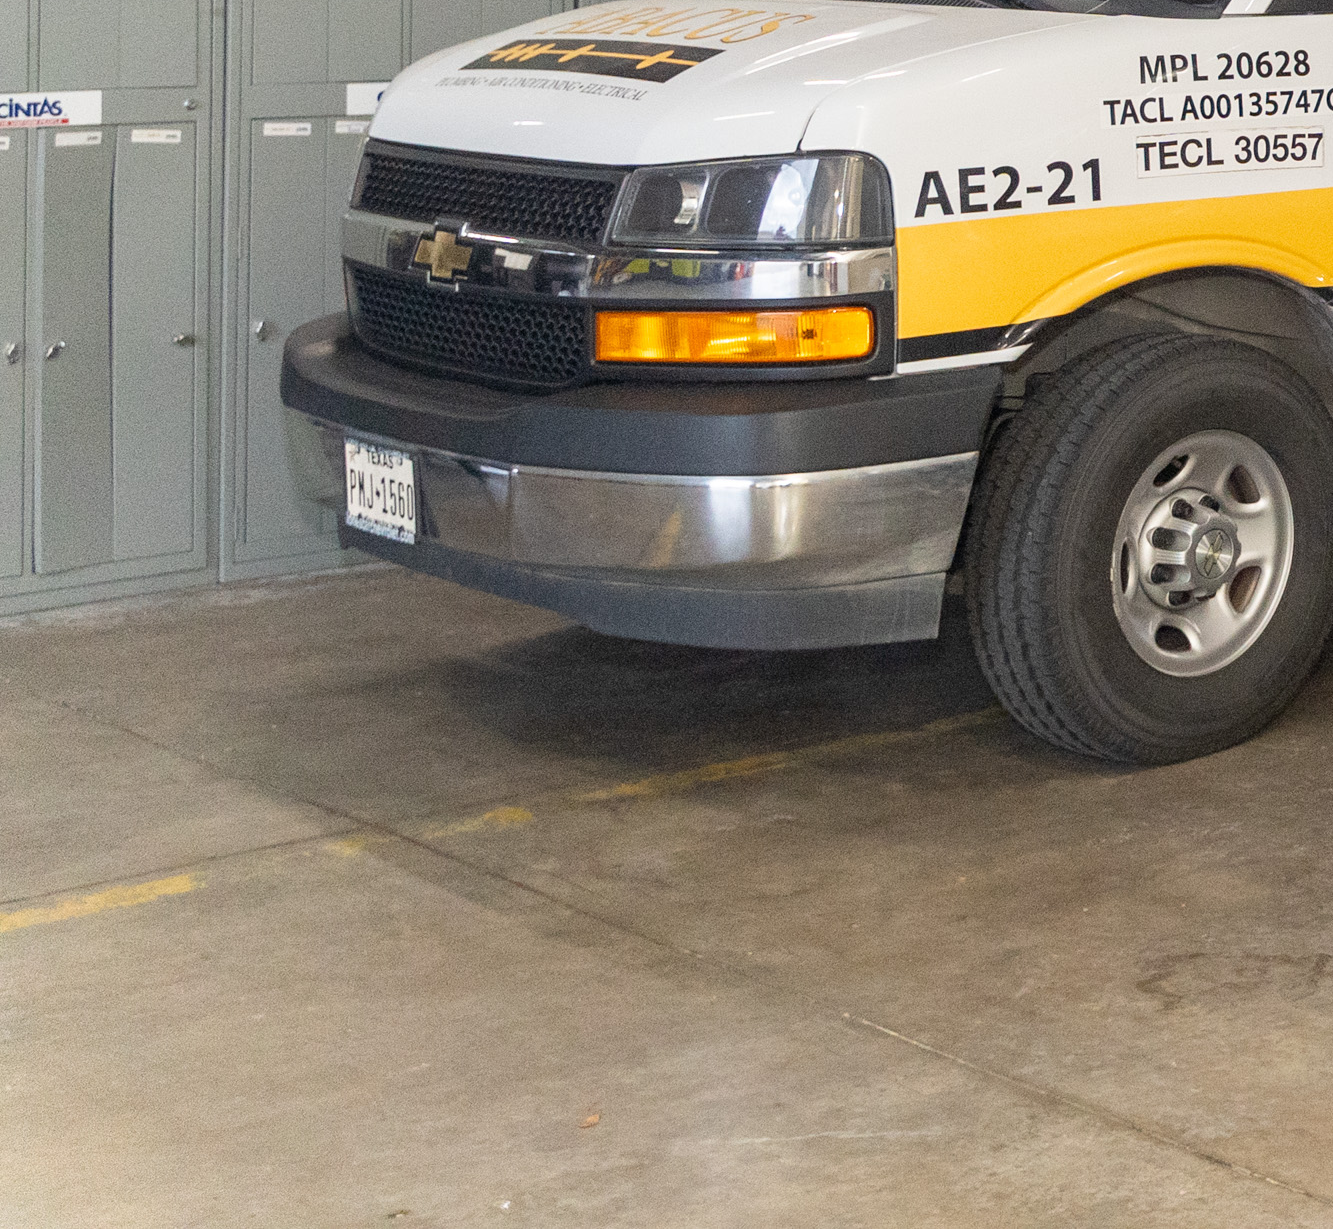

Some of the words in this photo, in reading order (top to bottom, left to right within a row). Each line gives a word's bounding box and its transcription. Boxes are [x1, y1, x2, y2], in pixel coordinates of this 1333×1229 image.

[534, 7, 814, 43] ABACUS
[1139, 54, 1208, 85] MPL
[1217, 49, 1311, 80] 20628
[1103, 97, 1173, 126] TACL
[1136, 137, 1224, 171] TECL
[1234, 133, 1324, 164] 30557
[914, 158, 1102, 218] AE2-21
